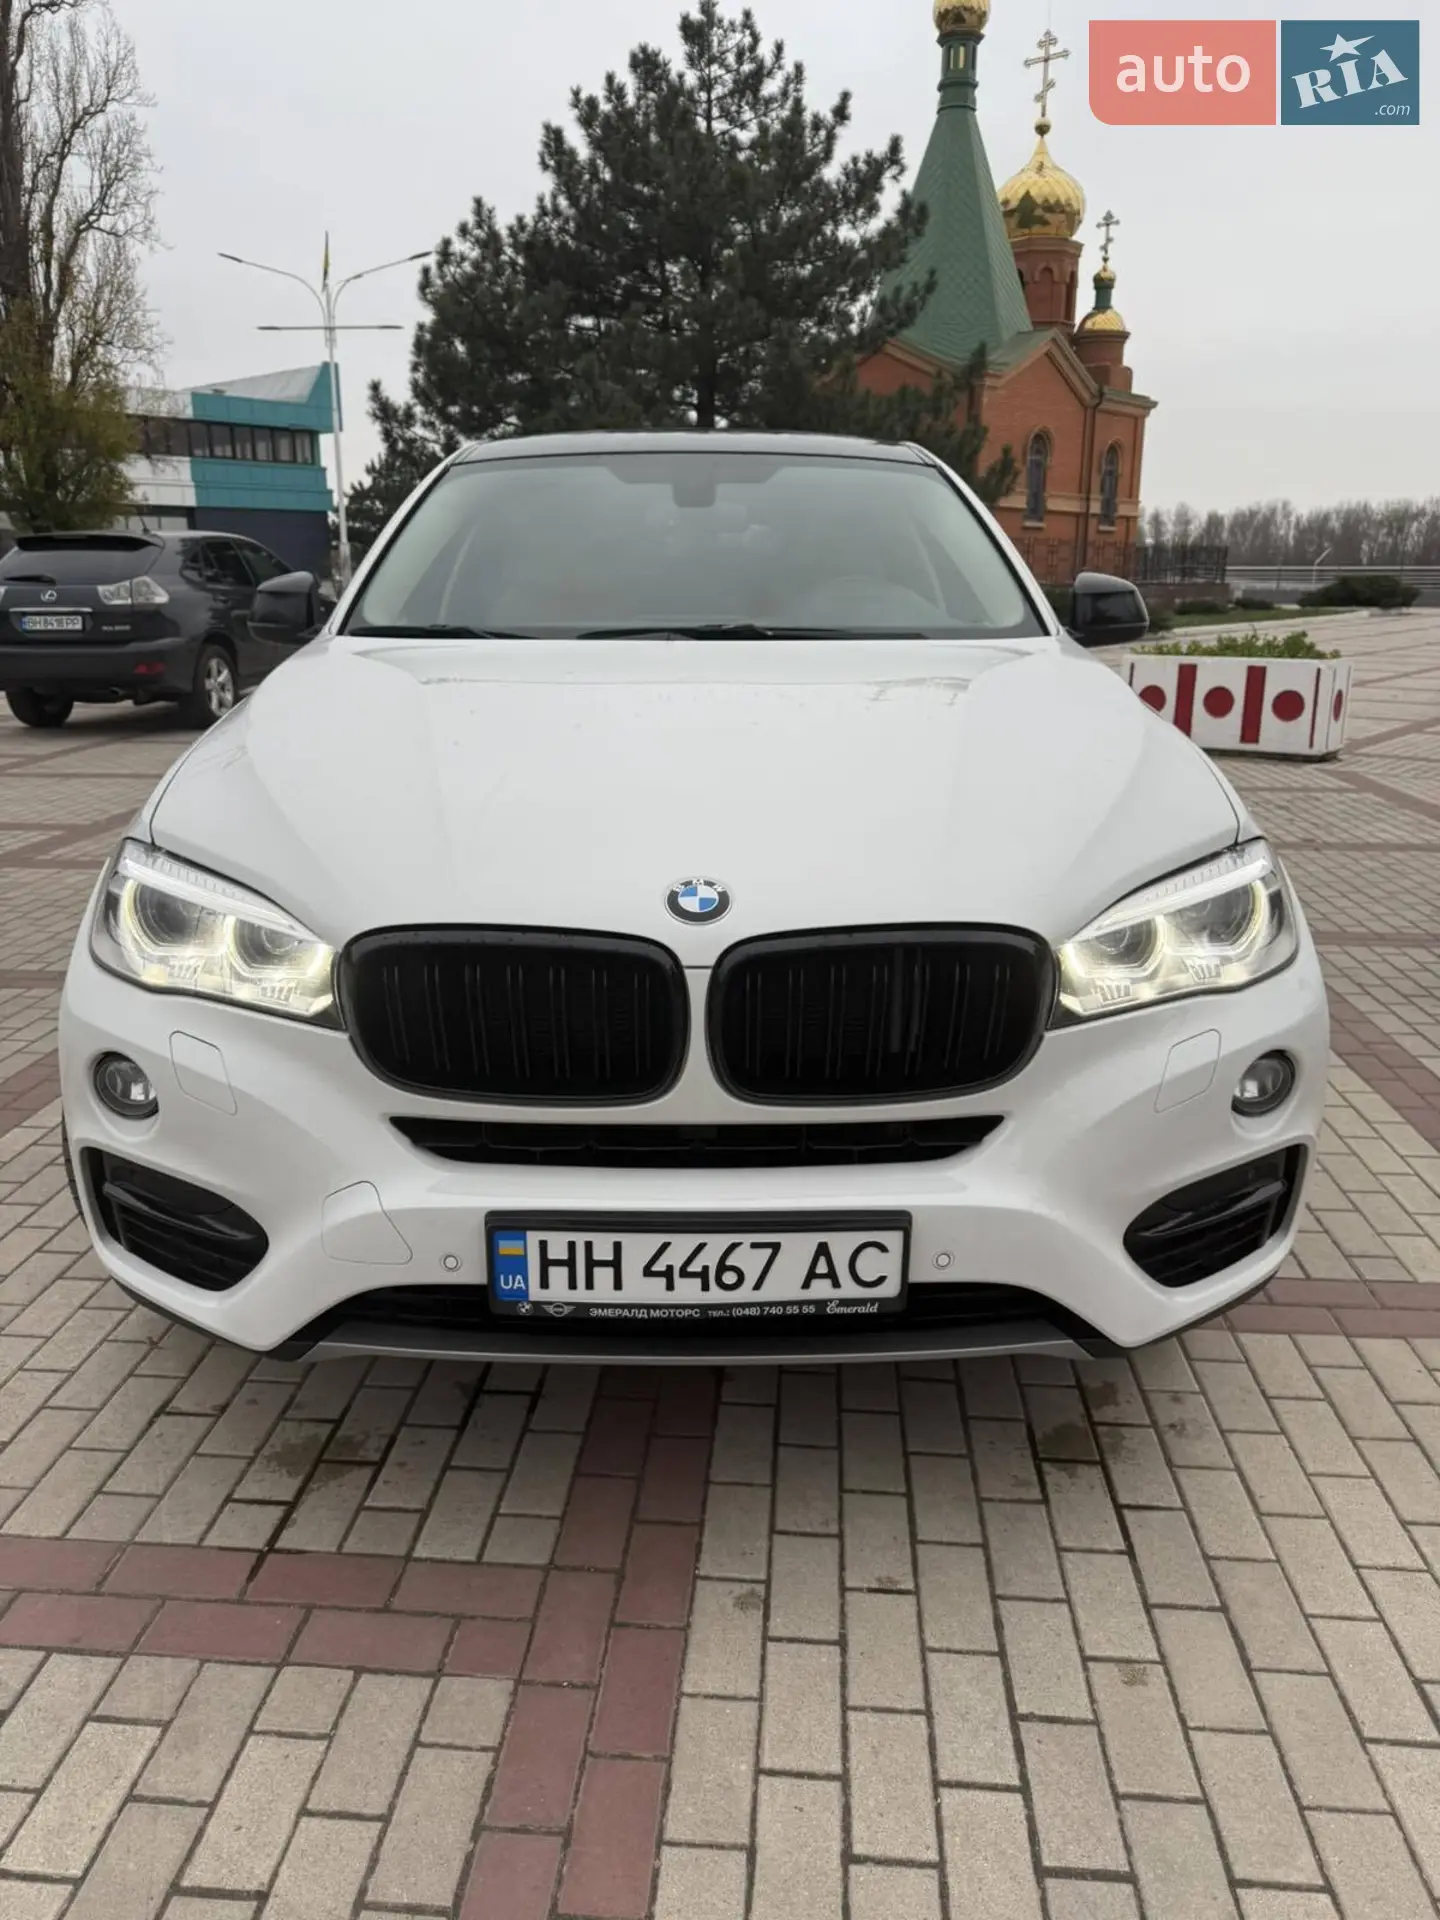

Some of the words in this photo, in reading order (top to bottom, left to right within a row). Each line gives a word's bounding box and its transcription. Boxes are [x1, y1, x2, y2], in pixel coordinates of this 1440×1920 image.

[538, 1239, 623, 1291] HH
[642, 1240, 782, 1293] 4467
[800, 1240, 890, 1291] AC
[500, 1274, 526, 1291] UA
[589, 1307, 649, 1319] ЭМЕРАЛД
[650, 1307, 701, 1318] МОТОРС
[732, 1306, 761, 1318] (048)
[762, 1305, 784, 1316] 740
[786, 1305, 799, 1314] 55
[801, 1304, 816, 1313] 55
[826, 1300, 879, 1314] Emerald
